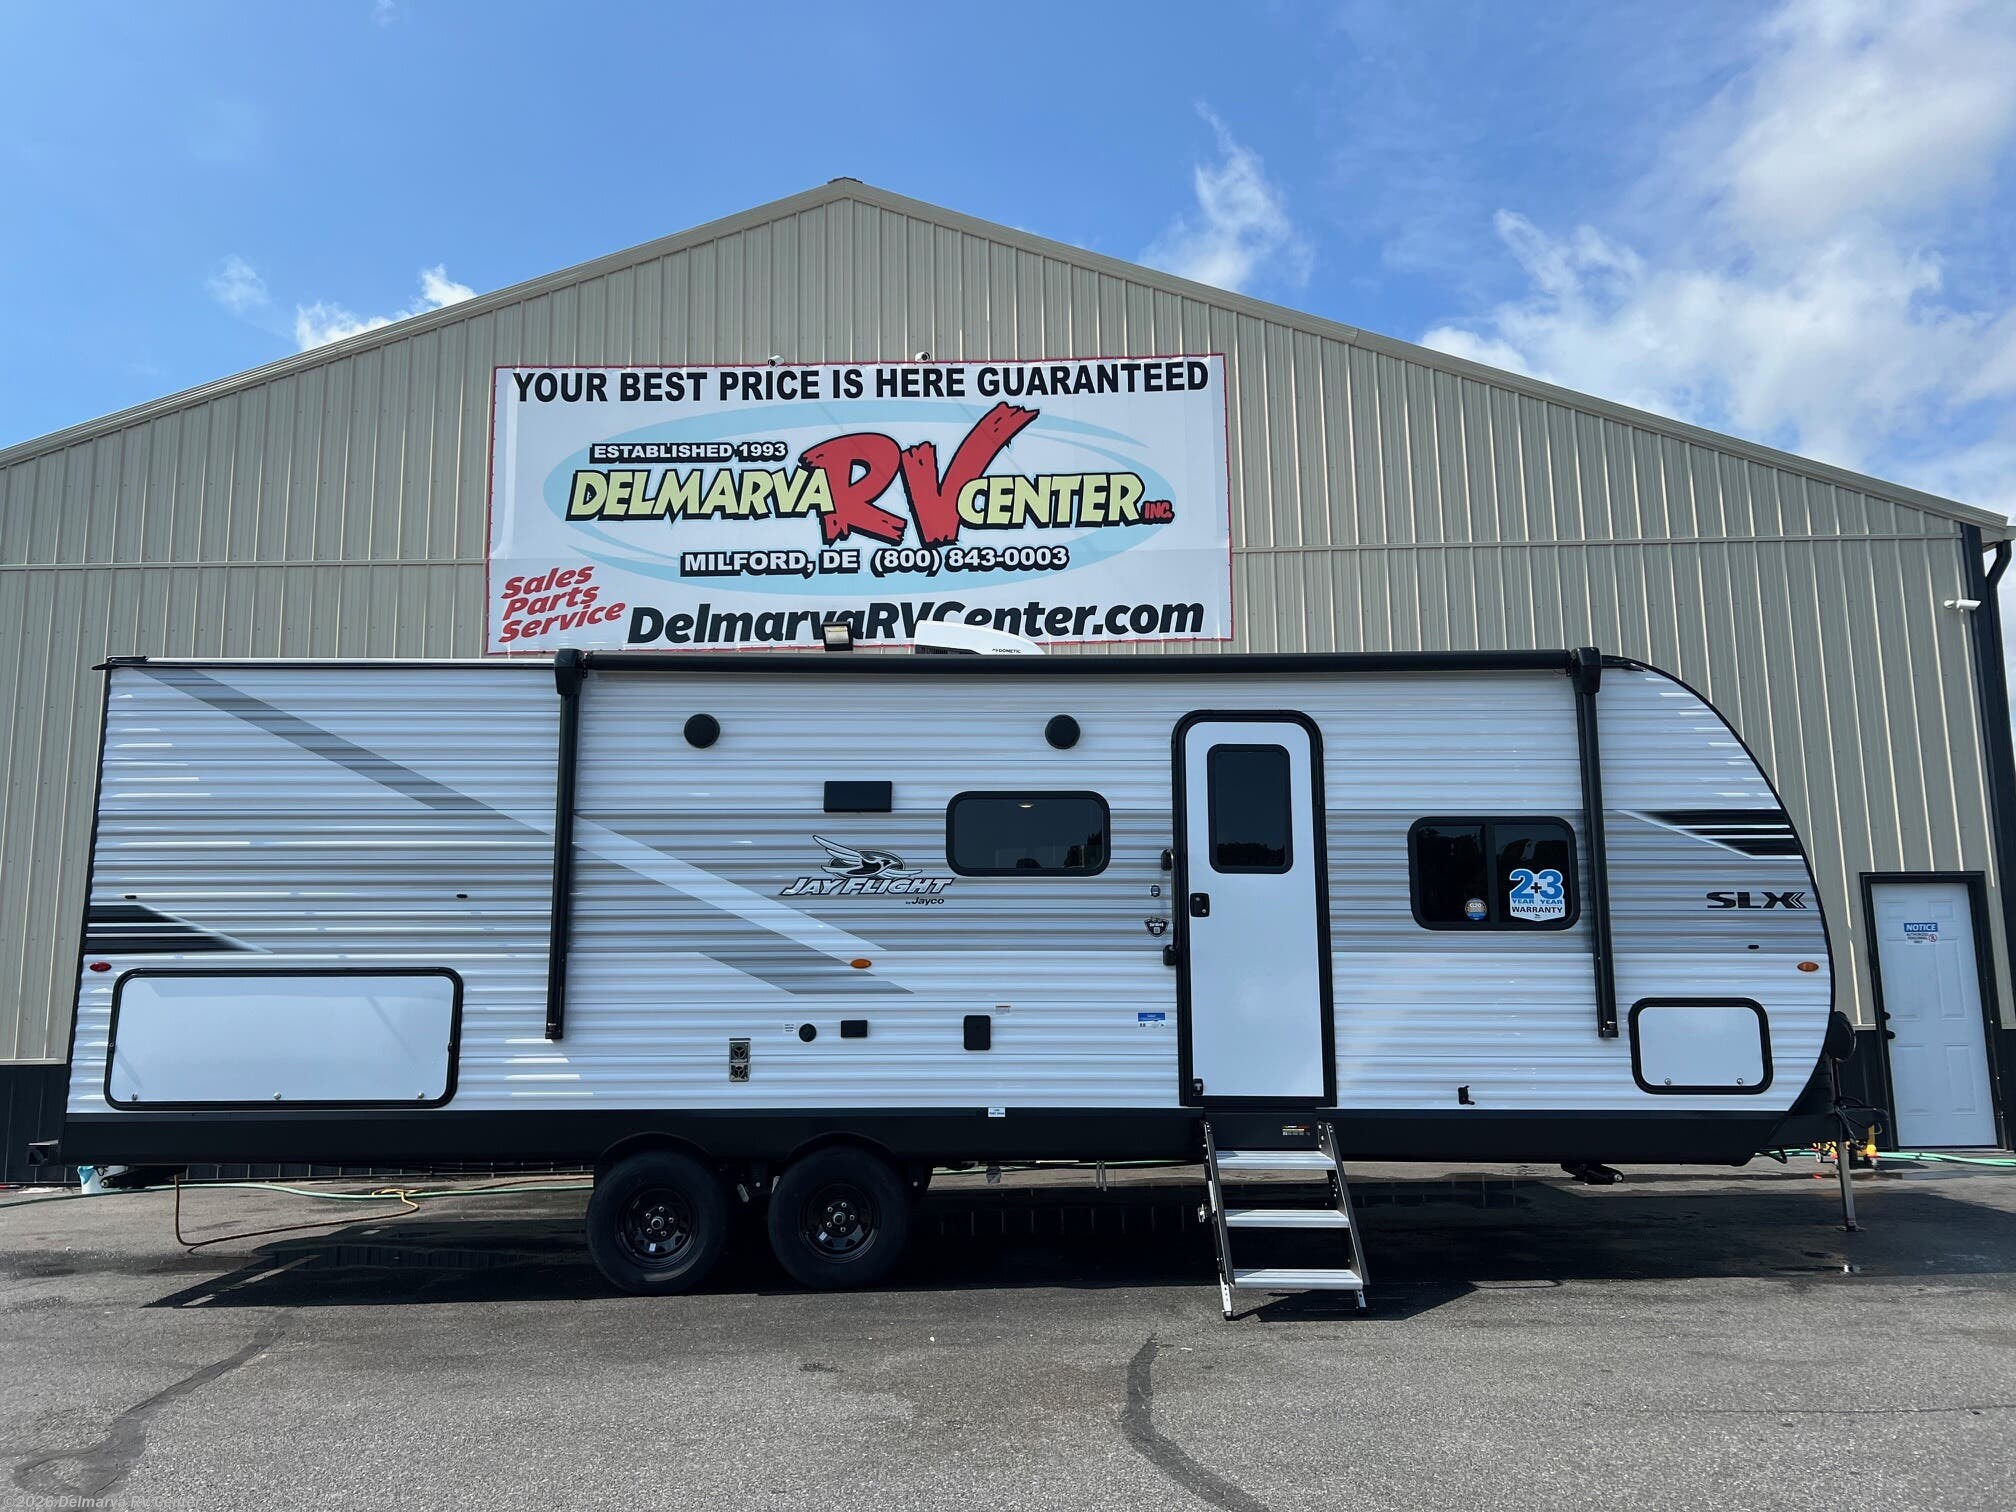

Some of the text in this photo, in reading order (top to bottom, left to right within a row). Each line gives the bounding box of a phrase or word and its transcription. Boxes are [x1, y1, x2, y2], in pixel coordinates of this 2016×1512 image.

[512, 361, 1209, 402] YOUR BEST PRICE IS HERE GUARANTEED
[593, 443, 786, 459] ESTABLISHED 1993
[568, 467, 837, 520] DELMARVA
[800, 401, 1041, 547] RV
[957, 472, 1147, 527] CENTER
[684, 547, 1069, 573] MILFORD, DE (800) 843-0003
[501, 565, 595, 599] Sales
[502, 586, 600, 621] Parts
[498, 602, 626, 643] Service
[779, 876, 956, 896] JAY FLIGHT
[911, 896, 945, 906] Jayco
[1706, 891, 1808, 909] SLX
